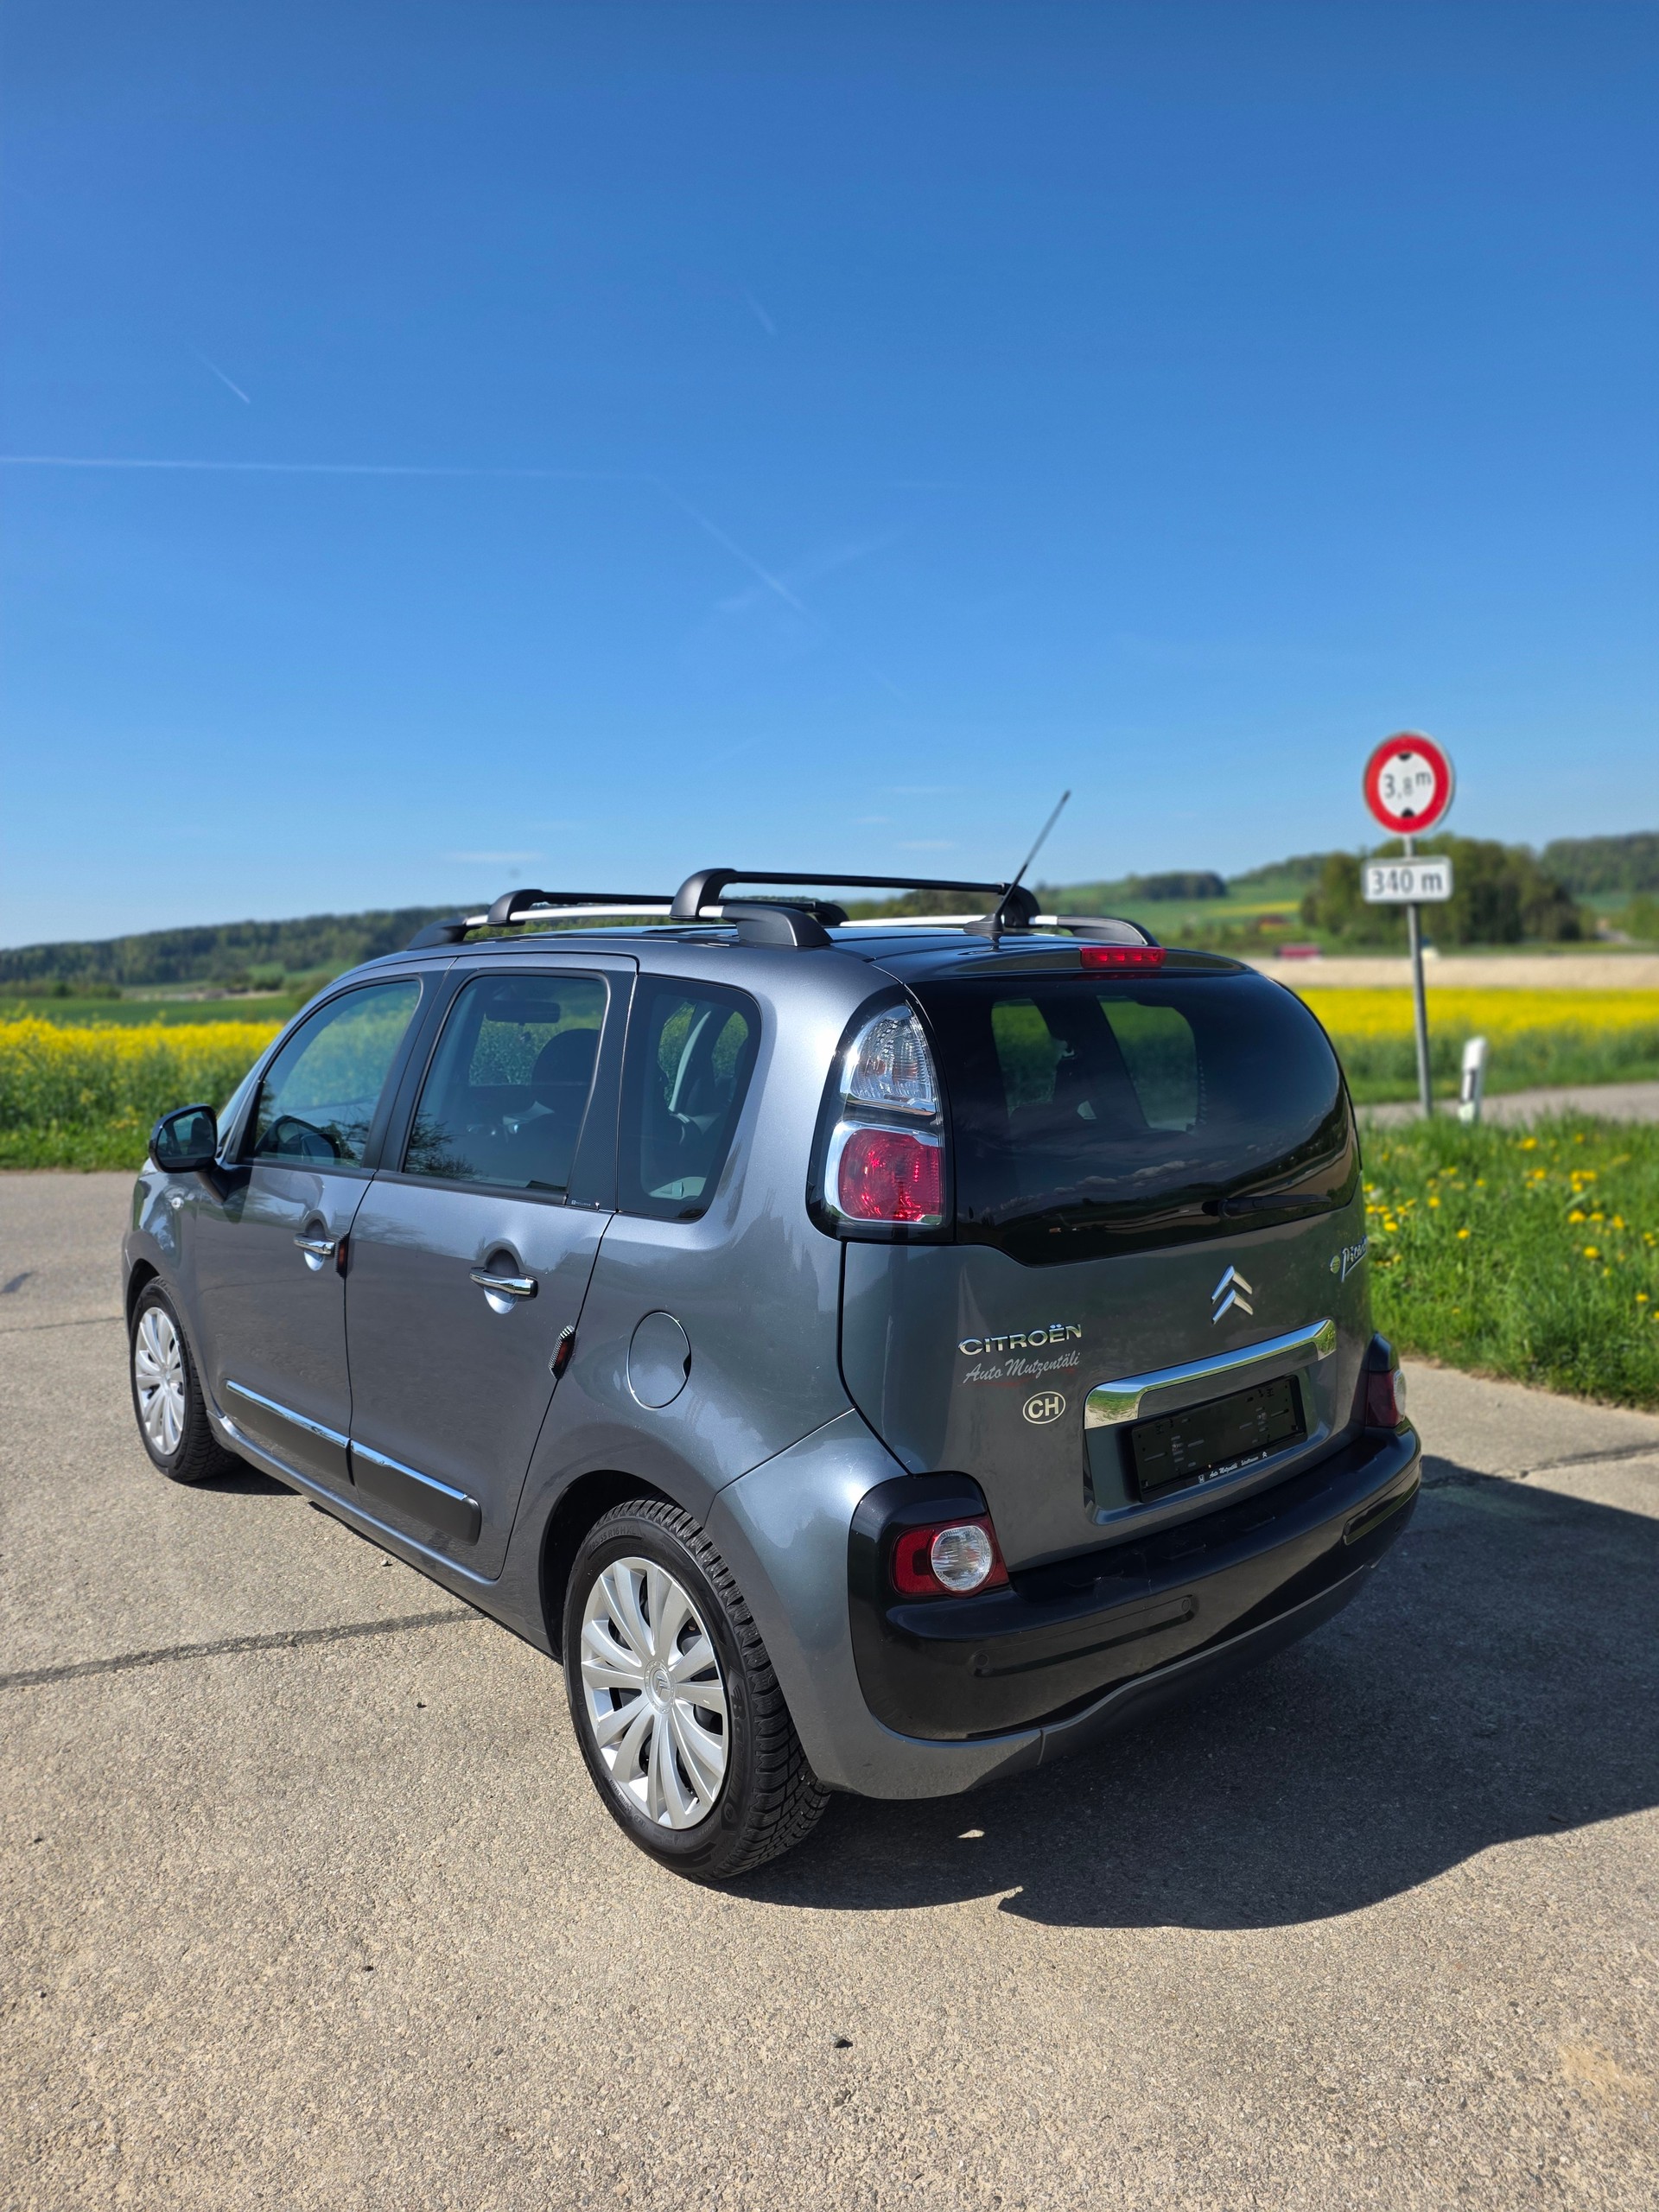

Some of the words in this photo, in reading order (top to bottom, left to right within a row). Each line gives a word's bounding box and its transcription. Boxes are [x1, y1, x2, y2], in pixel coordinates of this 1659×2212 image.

[1372, 868, 1414, 895] 340
[1421, 873, 1442, 891] m
[958, 1324, 1082, 1356] CITROËN
[963, 1363, 1003, 1384] Auto
[1005, 1350, 1081, 1379] Mutzentäli
[1027, 1396, 1059, 1419] CH
